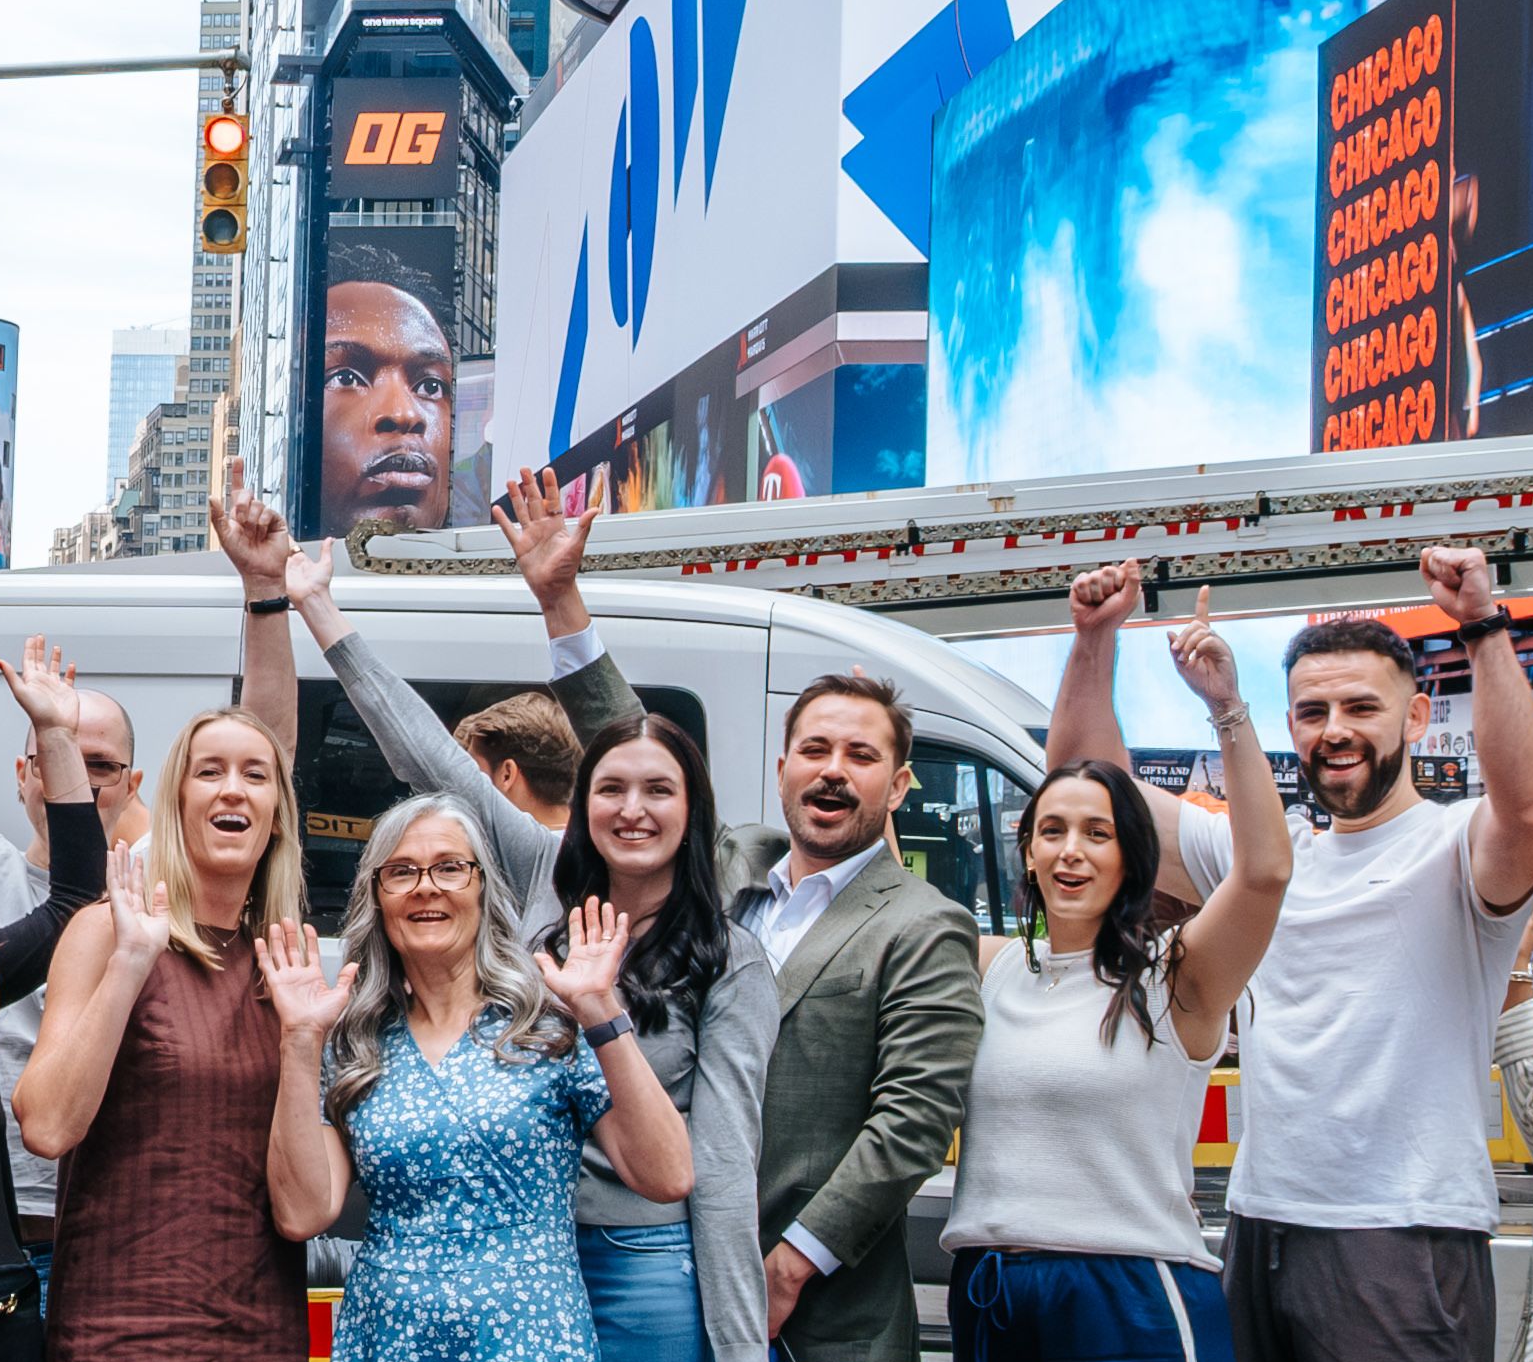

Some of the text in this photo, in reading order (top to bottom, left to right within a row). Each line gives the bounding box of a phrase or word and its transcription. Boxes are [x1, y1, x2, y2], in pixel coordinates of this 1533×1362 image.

[1330, 14, 1443, 132] CHICAGO
[344, 111, 447, 165] OG
[1329, 86, 1442, 200] CHICAGO
[1327, 158, 1441, 268] CHICAGO
[1326, 232, 1439, 336] CHICAGO
[1324, 305, 1438, 405] CHICAGO
